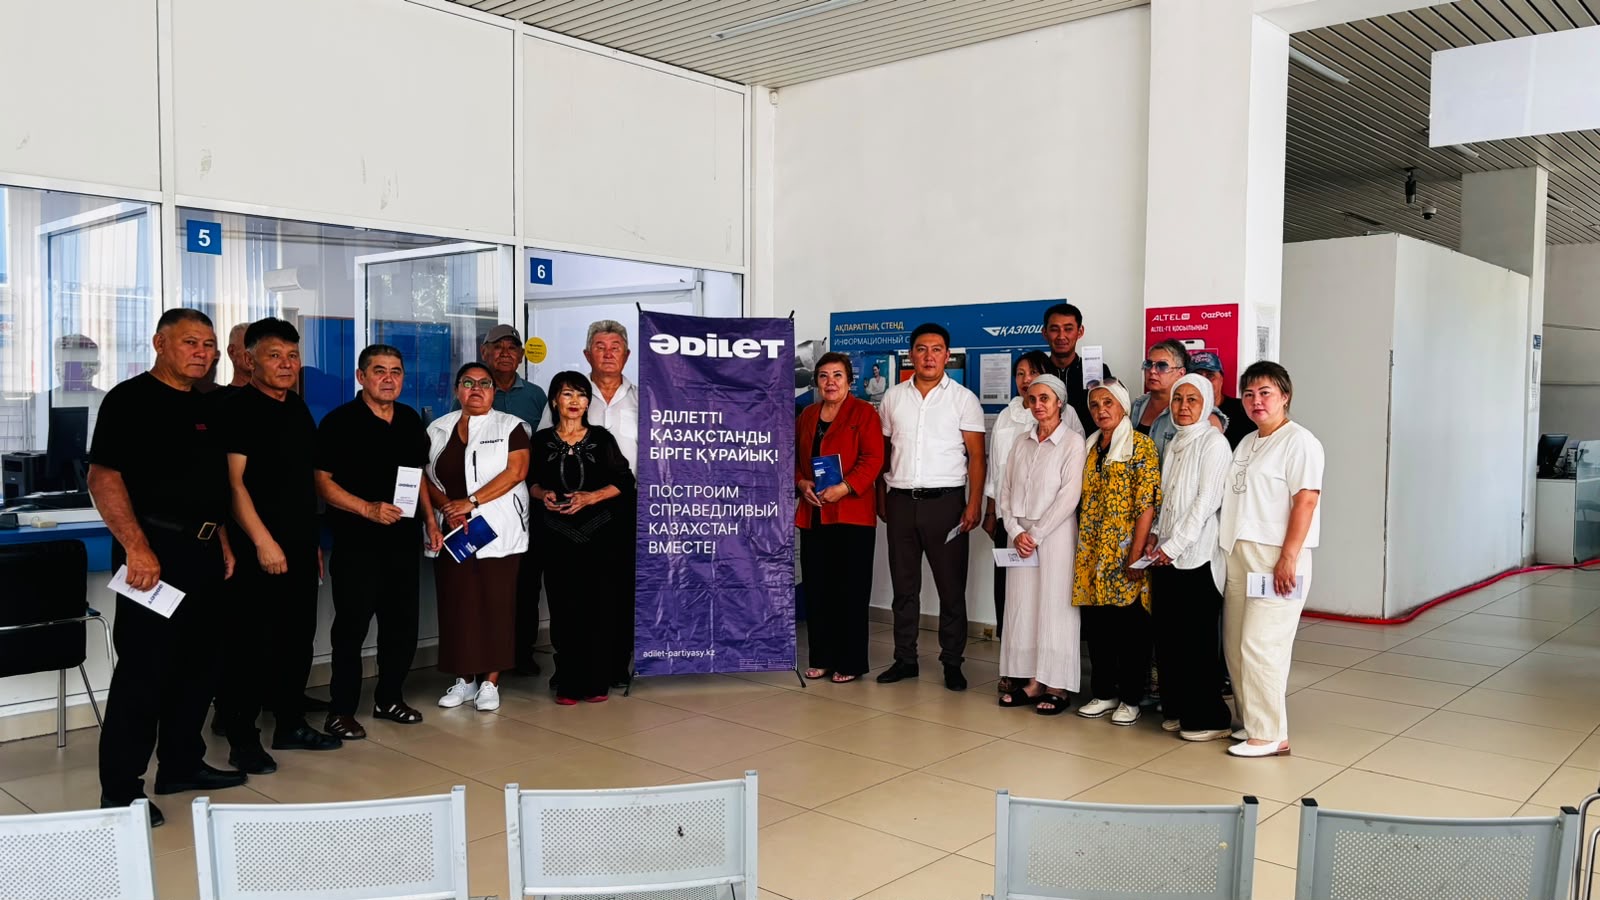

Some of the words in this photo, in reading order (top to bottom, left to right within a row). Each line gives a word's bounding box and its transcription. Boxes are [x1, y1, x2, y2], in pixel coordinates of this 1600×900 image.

[198, 228, 211, 247] 5
[537, 264, 546, 279] 6
[1152, 313, 1181, 321] ALTEL
[1201, 310, 1232, 319] QazPost
[834, 322, 880, 333] АҚПАРАТТЫҚ
[880, 321, 905, 331] СТЕНД
[834, 335, 904, 346] ИНФОРМАЦИОННЫЙ
[651, 409, 723, 425] ӘДІЛЕТТІ
[650, 428, 771, 446] ҚАЗАҚСТАНДЫ
[650, 447, 693, 461] БІРГЕ
[696, 446, 779, 464] ҚҰРАЙЫҚ!
[649, 485, 739, 499] ПОСТРОИМ
[649, 502, 778, 519] СПРАВЕДЛИВЫЙ
[649, 522, 739, 536] КАЗАХСТАН
[649, 541, 716, 555] ВМЕСТЕ!
[643, 649, 716, 659] adilet-partiyasy.kz
